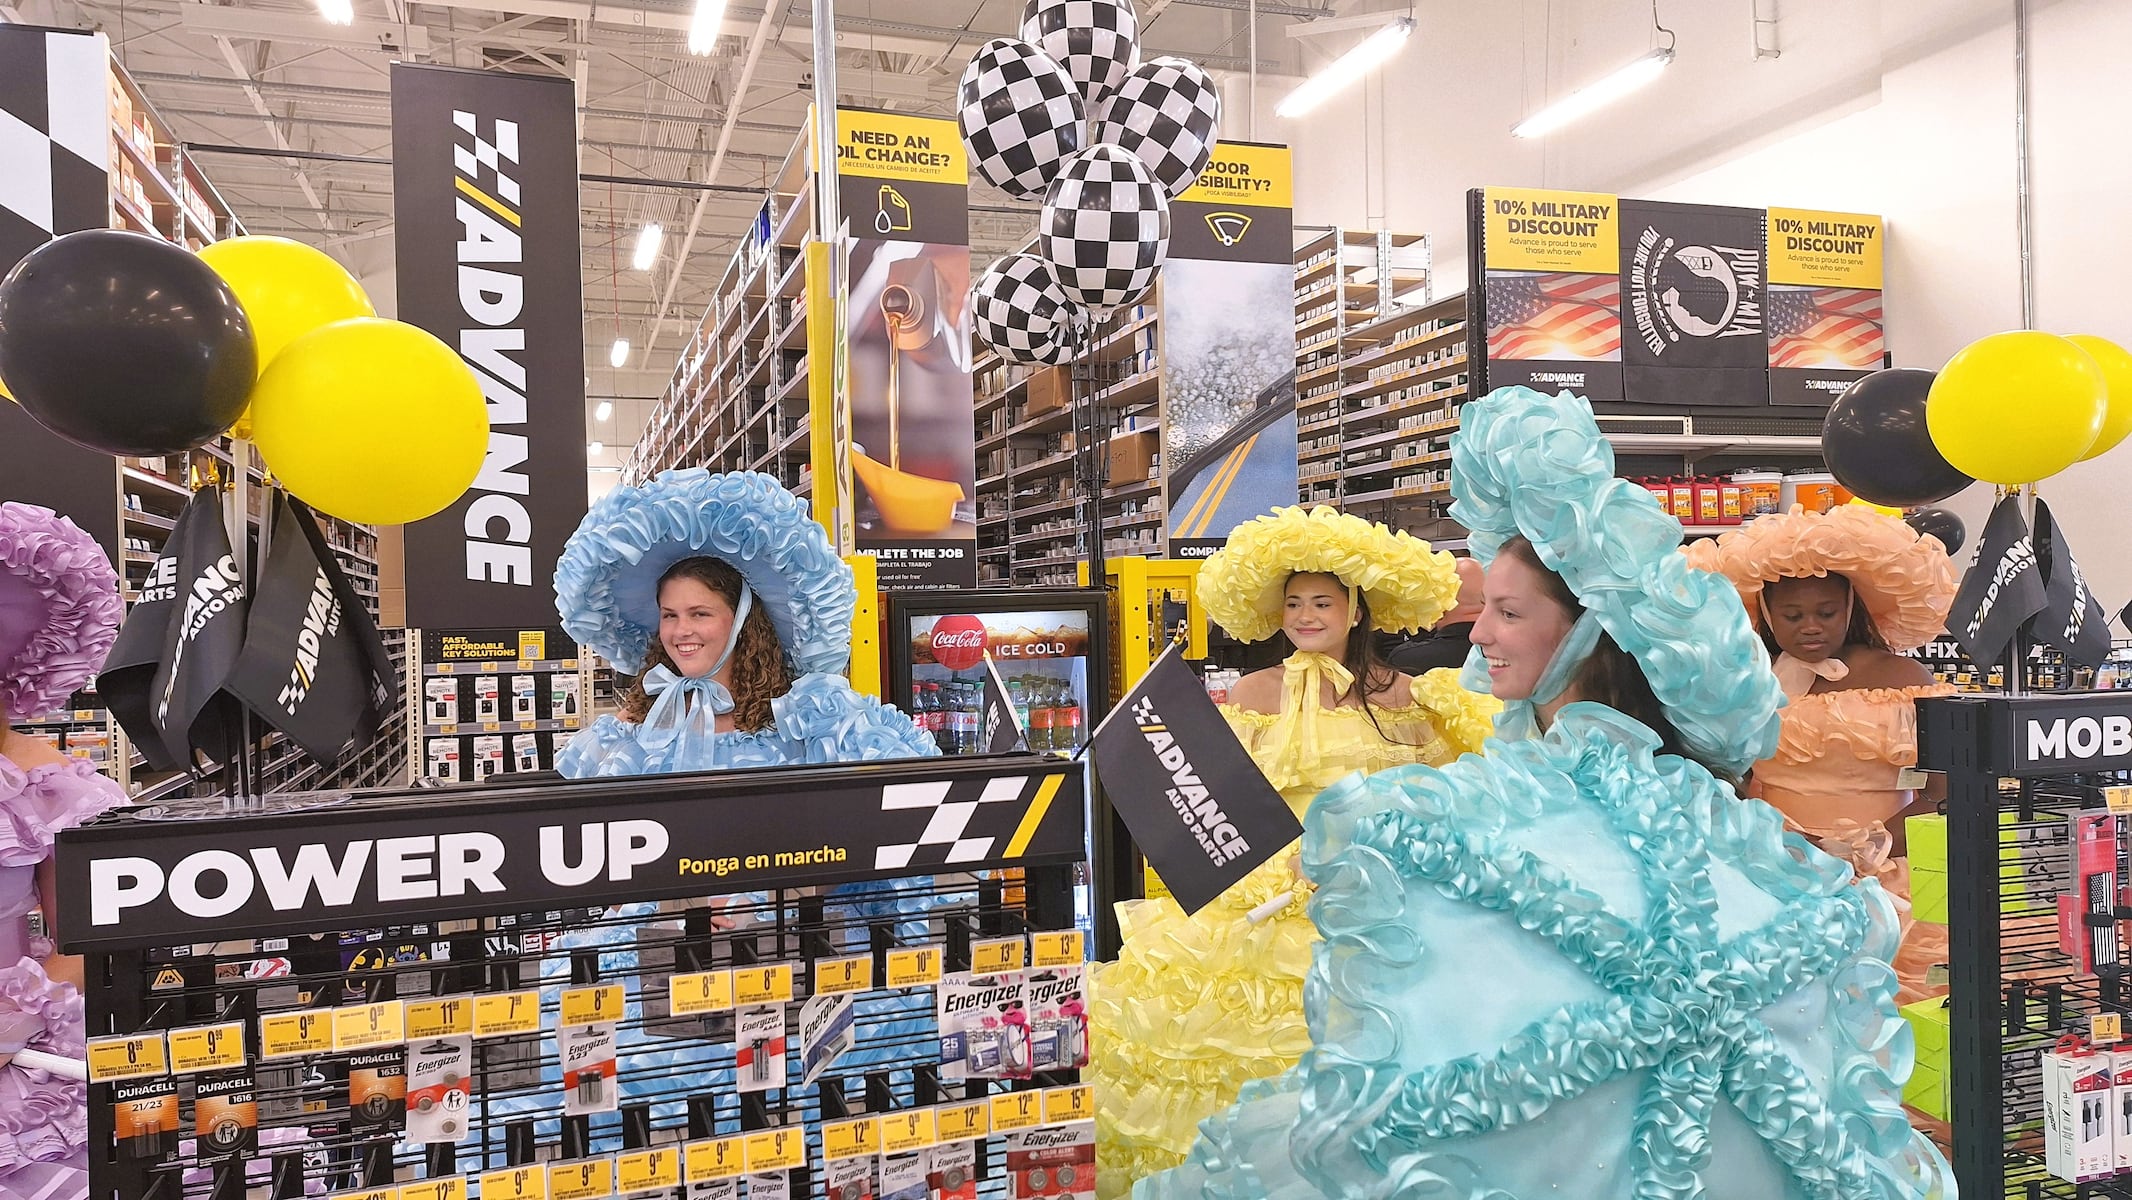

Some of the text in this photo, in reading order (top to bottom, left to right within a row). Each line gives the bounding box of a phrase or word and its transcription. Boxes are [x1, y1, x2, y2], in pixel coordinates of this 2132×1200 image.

[851, 130, 930, 150] NEED AN
[865, 147, 950, 167] CHANGE?
[1205, 161, 1250, 175] POOR
[1195, 175, 1271, 191] ISIBILITY?
[1493, 199, 1611, 220] 10% MILITARY
[1507, 218, 1599, 237] DISCOUNT
[1775, 218, 1876, 239] 10% MILITARY
[1509, 237, 1540, 246] Advance
[1548, 240, 1569, 248] proud
[1639, 225, 1660, 250] YOU
[1786, 236, 1865, 255] DISCOUNT
[1525, 246, 1545, 255] those
[1547, 247, 1562, 255] who
[1787, 254, 1814, 262] Advance
[1821, 256, 1839, 264] proud
[1802, 263, 1818, 271] those
[1631, 265, 1646, 290] NOT
[1710, 245, 1763, 339] POW MIA
[1631, 291, 1667, 357] FORGOTTEN
[1541, 372, 1585, 382] ADVANCE
[911, 548, 935, 558] THE
[938, 548, 964, 558] JOB
[2003, 561, 2028, 586] AUTO
[189, 598, 226, 641] AUTO
[296, 566, 336, 684] ADVAN
[442, 643, 505, 651] AFFORDABLE
[932, 629, 984, 649] Coca-Cola
[442, 649, 516, 658] KEY SOLUTIONS
[996, 643, 1066, 657] ICE COLD
[1925, 642, 1960, 659] FIX
[2027, 715, 2132, 761] MOB
[1143, 731, 1251, 862] ADVANCE
[1164, 788, 1228, 868] AUTO PARTS
[678, 845, 847, 877] Ponga en marcha
[90, 820, 670, 927] POWER UP
[944, 982, 1023, 1014] Energizer
[1029, 975, 1081, 1002] ergizer
[741, 1013, 781, 1033] Energizer
[568, 1037, 610, 1056] Energizer
[942, 1037, 959, 1050] 25
[350, 1053, 402, 1066] DURACELL
[415, 1054, 462, 1073] Energizer
[568, 1052, 588, 1062] A23
[380, 1068, 401, 1077] 1632
[117, 1082, 176, 1100] DURACELL
[197, 1078, 253, 1094] DURACELL
[132, 1100, 163, 1112] 21/23
[231, 1094, 252, 1103] 1616
[1023, 1131, 1080, 1146] Energizer
[884, 1156, 920, 1177] Energizer
[937, 1153, 972, 1168] Energizer
[833, 1165, 868, 1183] Energizer
[751, 1182, 785, 1194] Energizer
